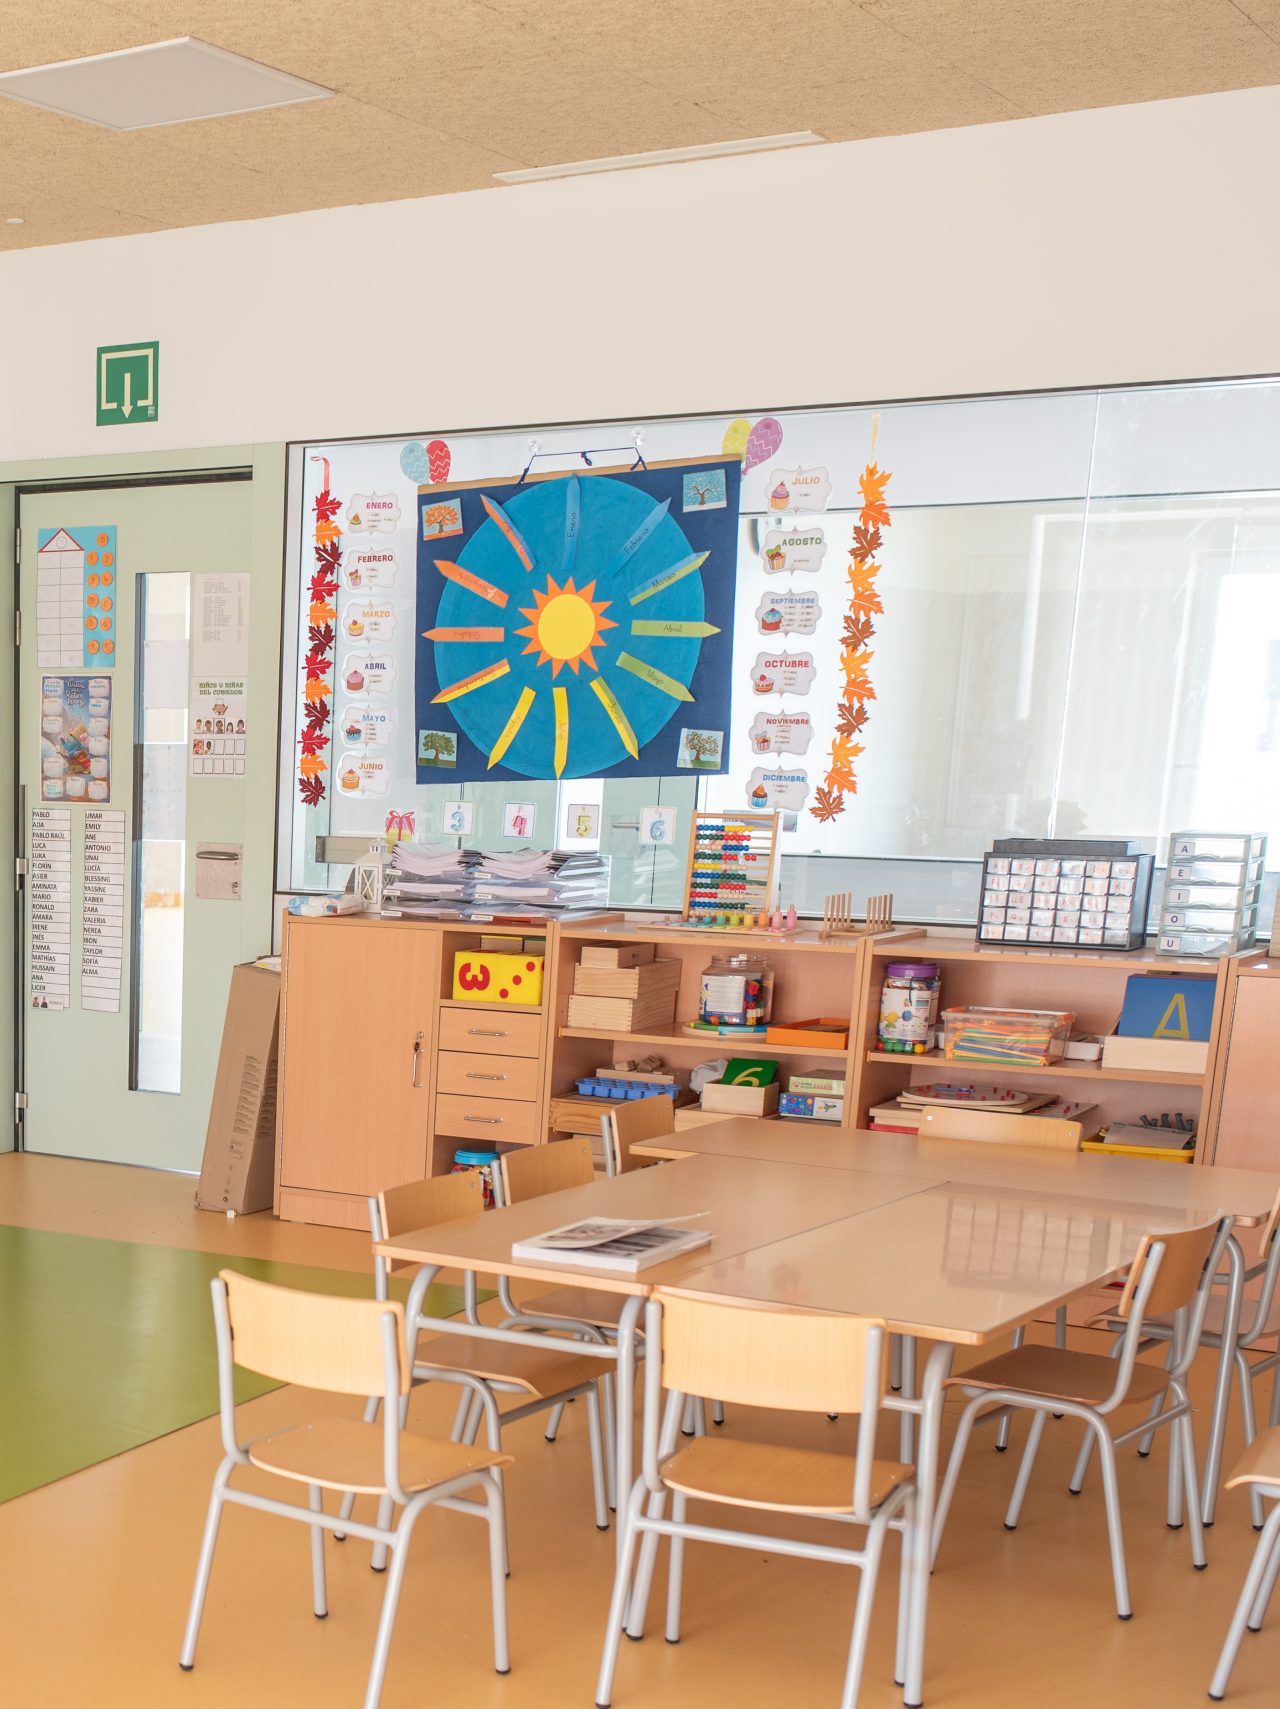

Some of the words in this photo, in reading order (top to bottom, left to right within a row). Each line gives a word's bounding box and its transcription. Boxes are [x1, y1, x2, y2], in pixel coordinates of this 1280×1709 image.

[792, 476, 820, 485] JULIO
[782, 537, 822, 546] AGOSTO
[362, 610, 390, 618] MARZO
[365, 662, 386, 670] ABRIL
[764, 660, 808, 669] OCTUBRE
[358, 762, 383, 770] JUNIO
[763, 774, 807, 782] DICIEMBRE
[451, 811, 465, 832] 3
[512, 814, 526, 836] 4
[575, 815, 592, 838] 5
[649, 820, 665, 840] 6
[1181, 845, 1188, 853] A
[1178, 869, 1183, 877] E
[1171, 916, 1178, 924] O
[1167, 940, 1173, 948] U
[1153, 994, 1189, 1040] A
[731, 1068, 763, 1086] 6
